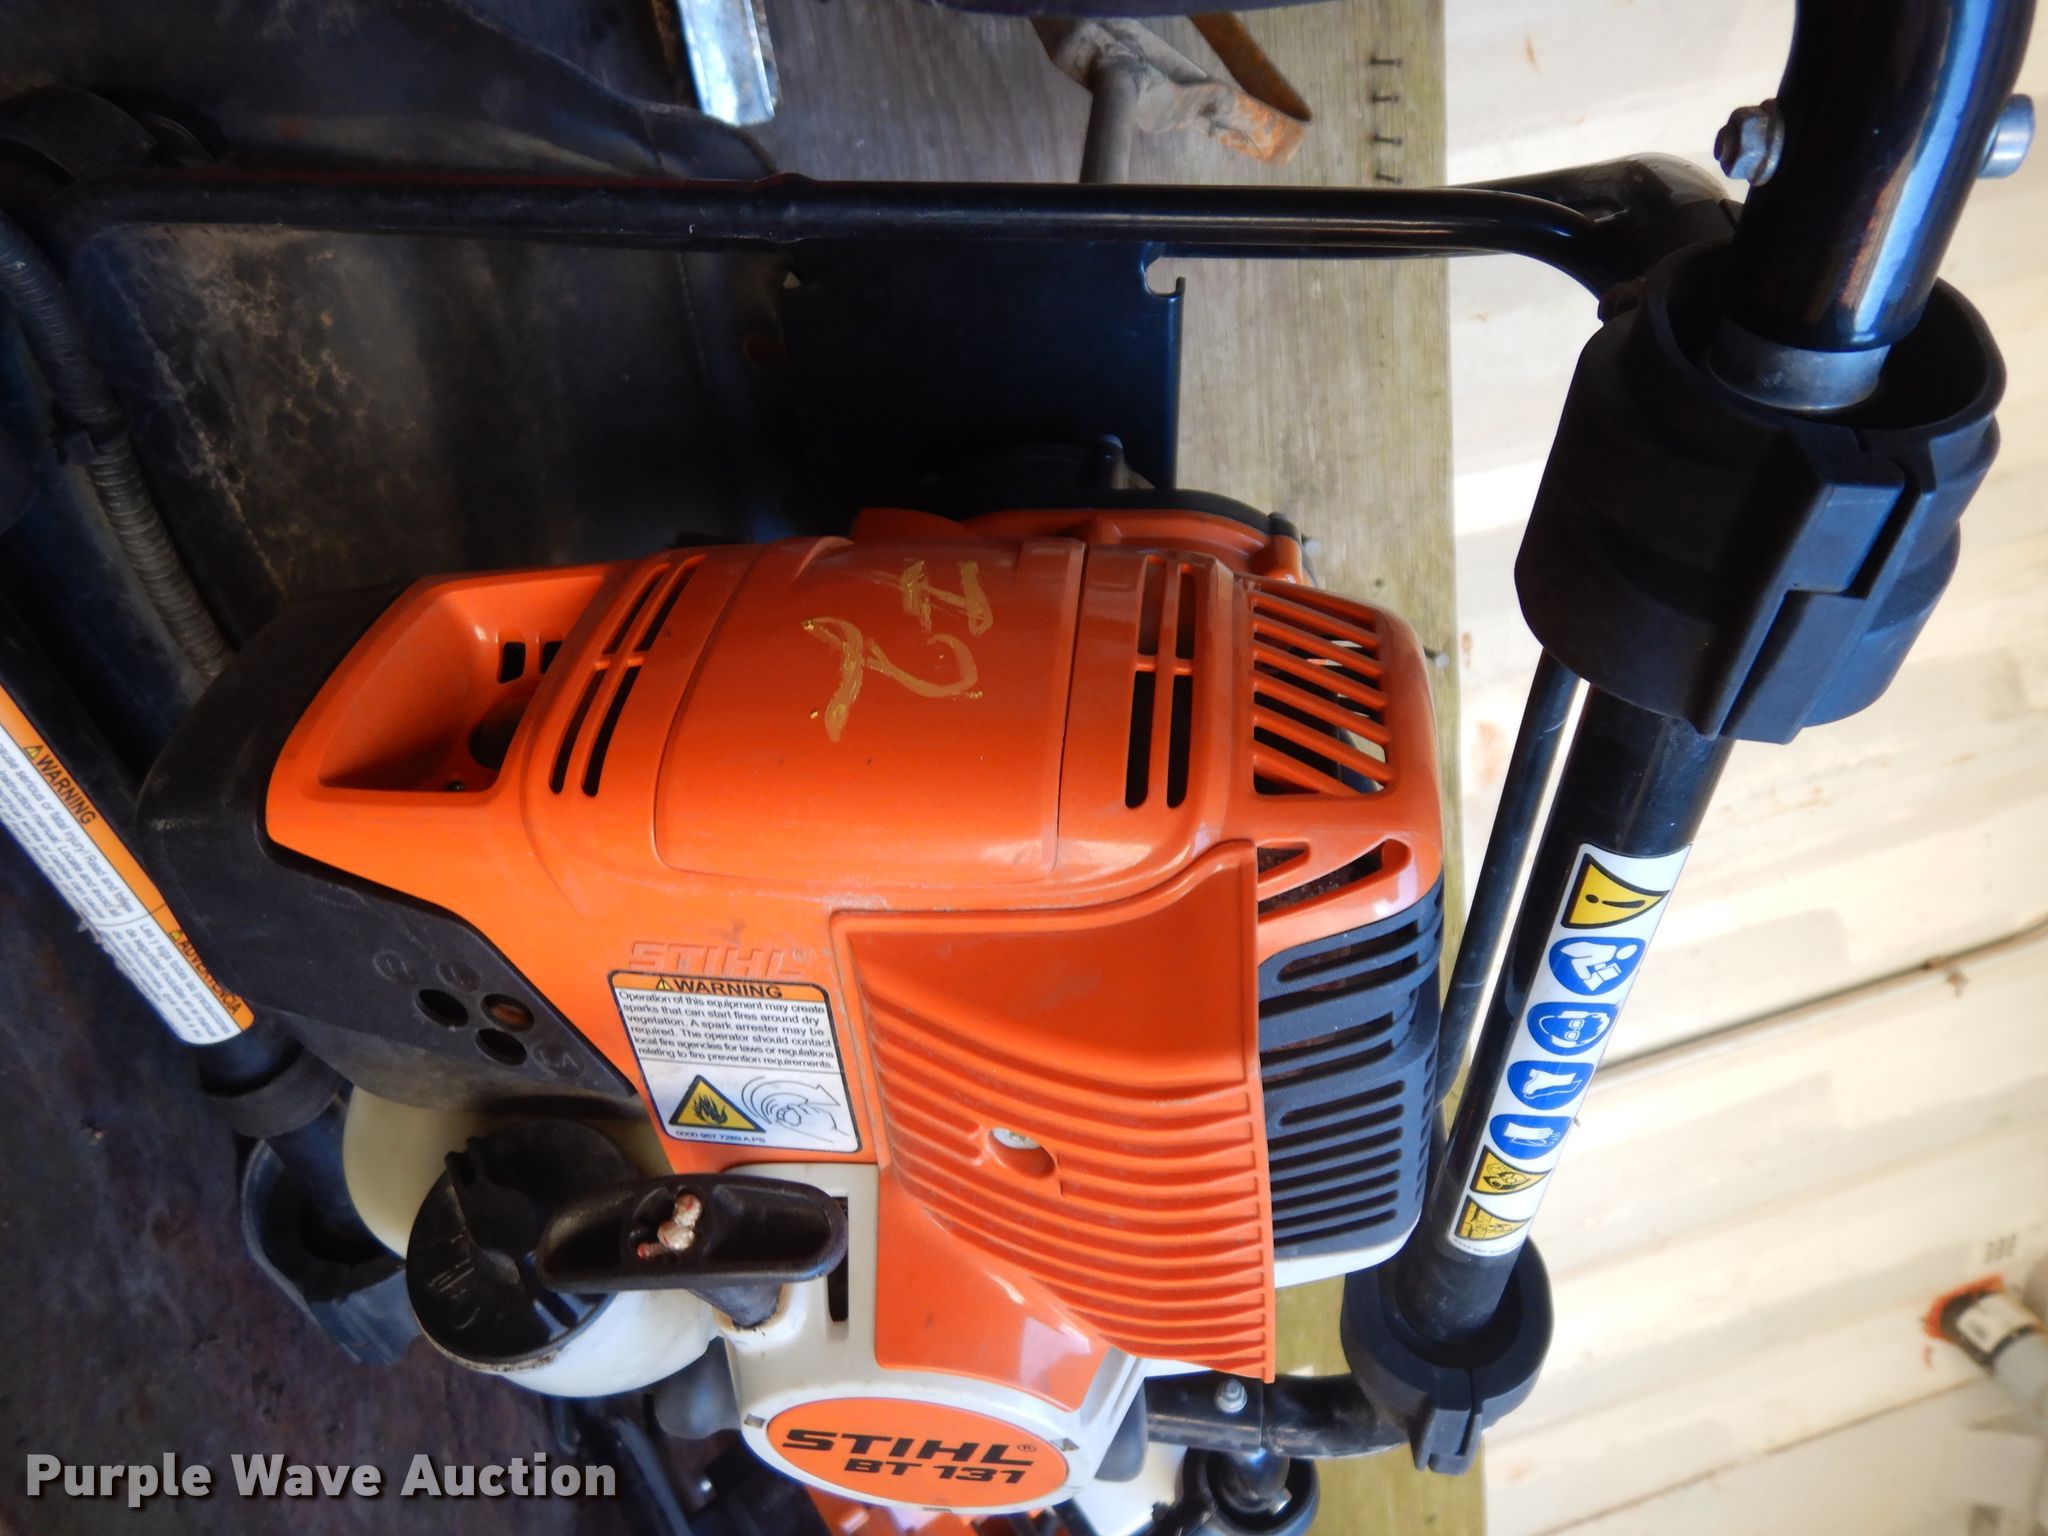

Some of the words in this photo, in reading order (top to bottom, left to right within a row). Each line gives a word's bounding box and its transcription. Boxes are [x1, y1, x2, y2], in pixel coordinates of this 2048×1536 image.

[37, 754, 96, 825] WARNING
[630, 942, 803, 978] STIHL
[674, 978, 783, 999] WARNING
[619, 991, 671, 1004] Operation
[673, 996, 684, 1005] of
[685, 997, 704, 1006] this
[707, 999, 763, 1010] equipment
[766, 1005, 788, 1013] may
[791, 1005, 825, 1014] create
[623, 1004, 659, 1013] sparks
[661, 1005, 681, 1015] that
[685, 1009, 705, 1017] can
[708, 1010, 731, 1019] start
[734, 1011, 757, 1020] fires
[760, 1014, 799, 1024] around
[801, 1015, 820, 1026] dry
[627, 1015, 688, 1026] vegetation.
[690, 1018, 699, 1027] A
[701, 1021, 732, 1030] spark
[735, 1024, 778, 1033] arrester
[782, 1027, 807, 1036] may
[810, 1027, 824, 1036] be
[631, 1026, 679, 1036] required.
[683, 1028, 702, 1038] The
[704, 1031, 748, 1040] operator
[752, 1035, 789, 1044] should
[791, 1038, 832, 1047] contact
[634, 1036, 658, 1045] local
[660, 1038, 675, 1047] fire
[677, 1040, 722, 1051] agencies
[724, 1043, 737, 1051] for
[740, 1044, 763, 1053] laws
[765, 1046, 775, 1054] or
[778, 1048, 834, 1058] regulations
[639, 1047, 676, 1058] relating
[677, 1049, 687, 1058] to
[689, 1050, 705, 1059] fire
[707, 1052, 762, 1063] prevention
[764, 1057, 833, 1069] requirements.
[844, 1458, 923, 1476] BT
[933, 1465, 1027, 1484] 131
